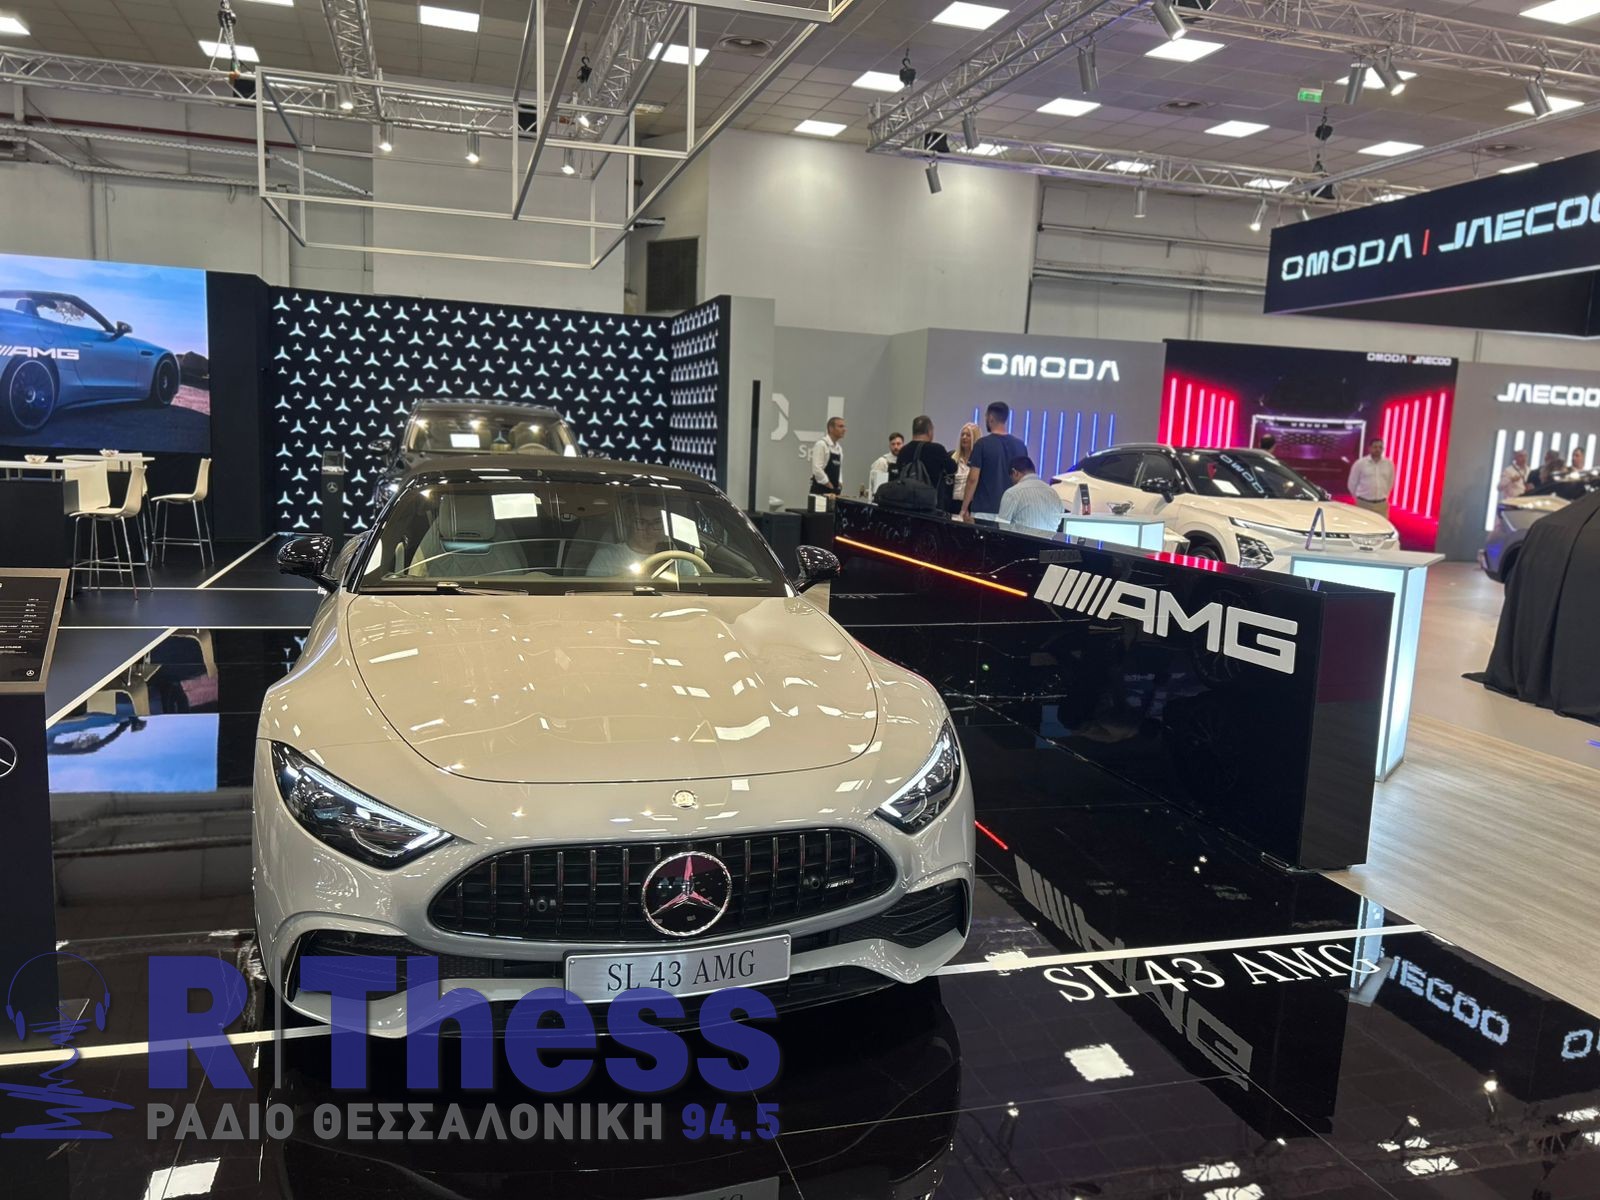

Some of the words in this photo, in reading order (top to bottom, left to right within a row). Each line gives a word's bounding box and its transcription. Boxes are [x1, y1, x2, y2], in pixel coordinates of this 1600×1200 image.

[1281, 233, 1412, 281] OMODA
[981, 352, 1121, 383] OMODA
[1366, 352, 1407, 364] OMODA
[1496, 382, 1600, 408] JAECOO
[607, 962, 641, 991] SL
[650, 960, 683, 989] 43
[692, 949, 756, 985] AMG
[1043, 964, 1139, 1003] SL
[1144, 956, 1225, 993] 43
[1232, 943, 1382, 986] AMG
